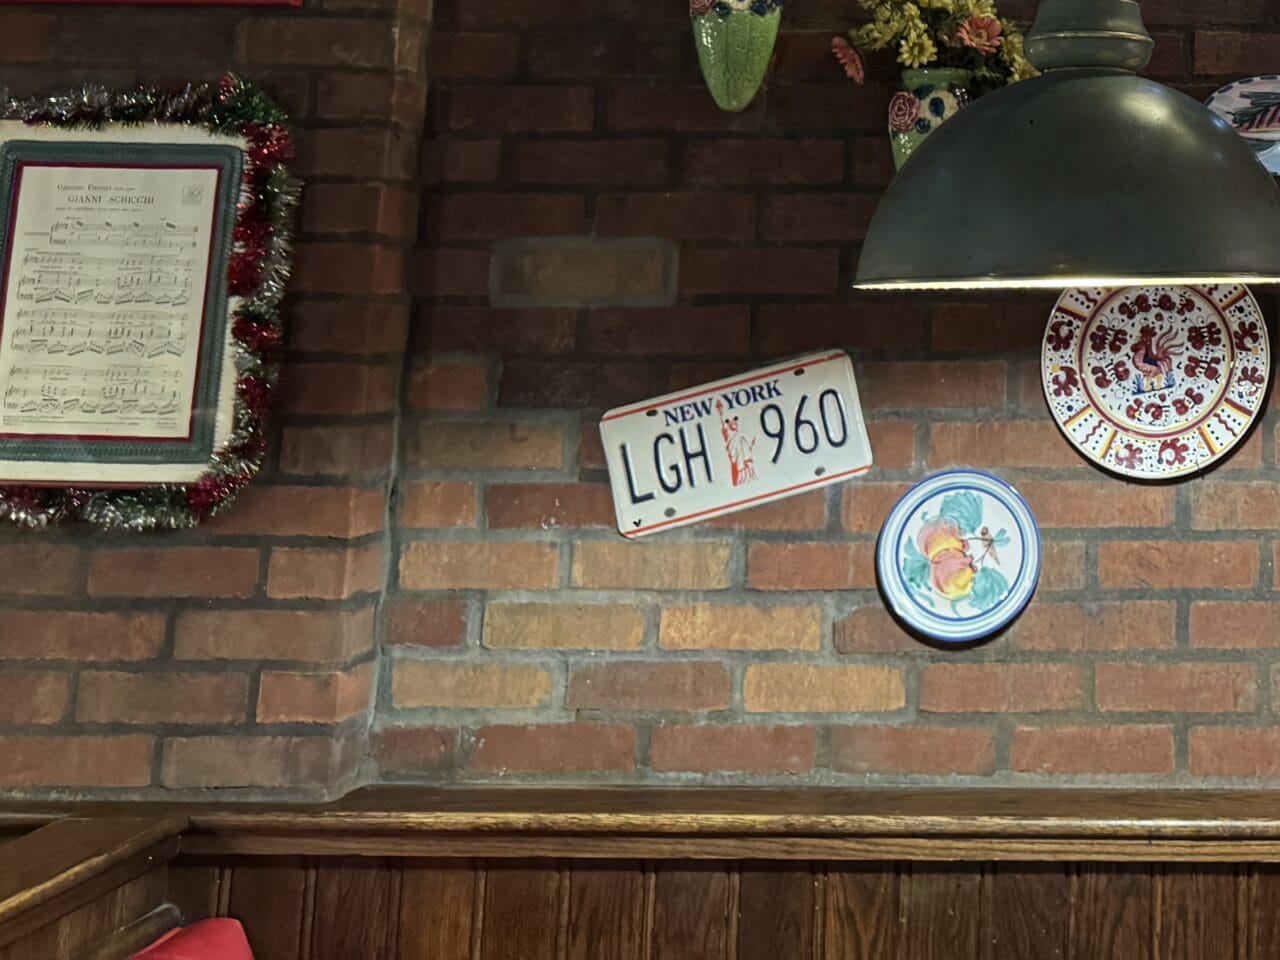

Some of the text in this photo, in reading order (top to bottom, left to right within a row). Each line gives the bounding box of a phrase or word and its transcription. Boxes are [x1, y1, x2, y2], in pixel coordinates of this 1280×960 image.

[662, 379, 784, 427] NEW YORK
[619, 387, 849, 505] LGH 960
